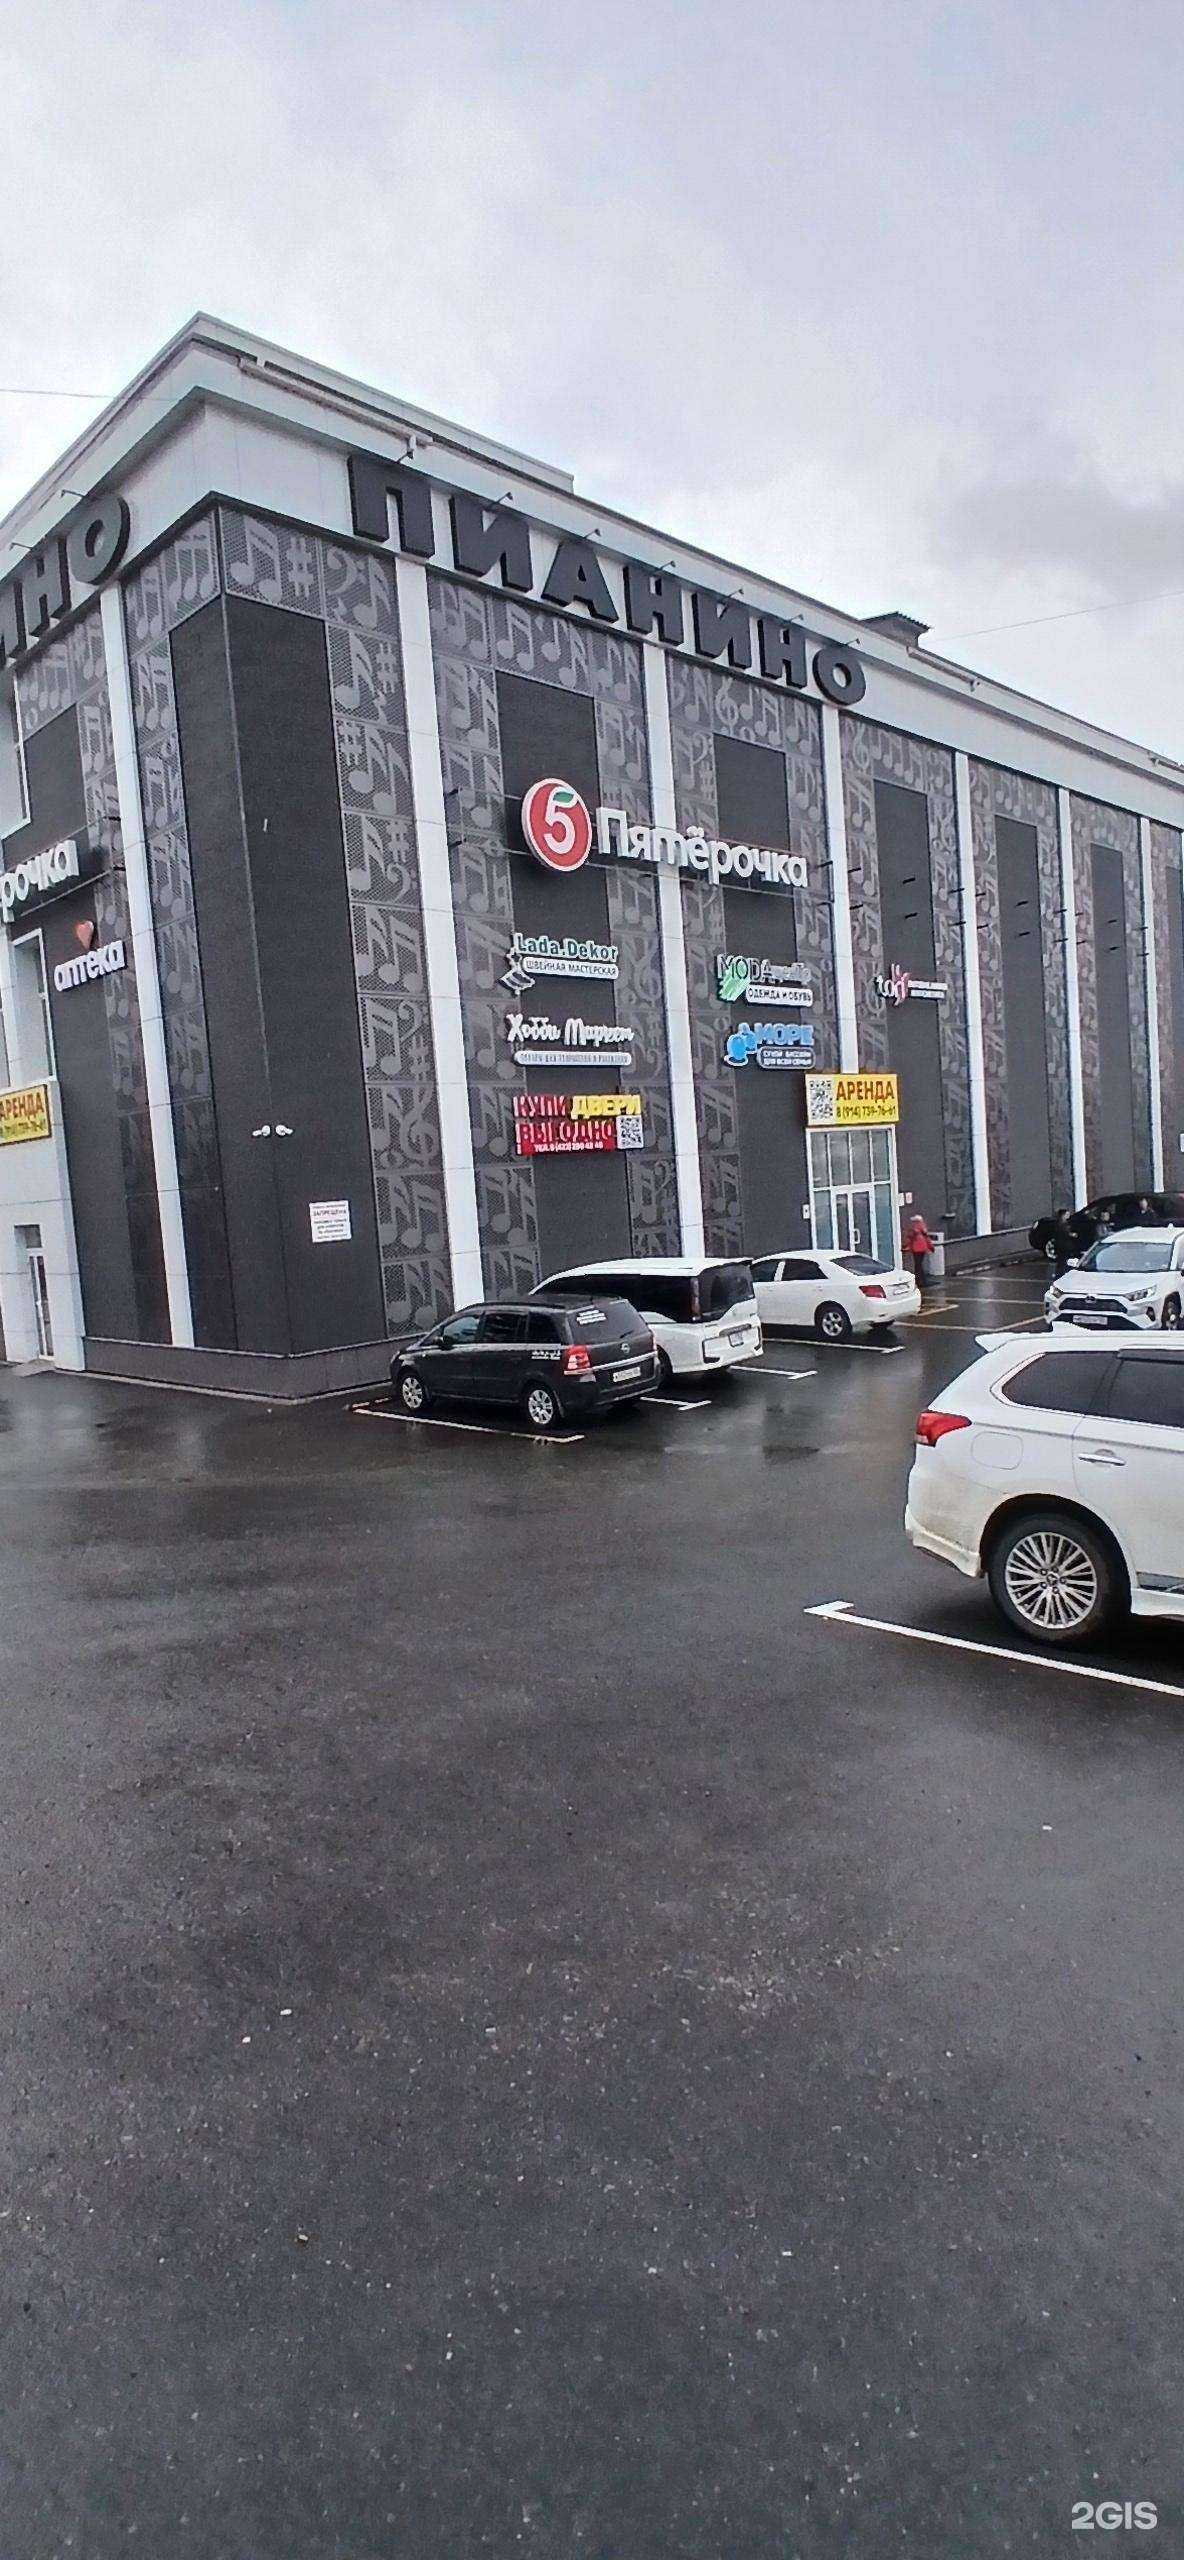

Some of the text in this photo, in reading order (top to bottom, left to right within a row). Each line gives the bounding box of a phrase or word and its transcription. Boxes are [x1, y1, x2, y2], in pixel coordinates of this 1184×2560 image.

[347, 455, 867, 706] ПИАНИНО
[596, 806, 808, 888] Пятёрочка
[54, 940, 126, 992] аптека
[568, 963, 617, 976] МАСТЕРСКАЯ
[747, 988, 781, 999] ОДЕЖДА
[789, 991, 812, 1002] ОБУВЬ
[754, 1022, 815, 1047] МОРЕ
[836, 1081, 895, 1103] АРЕНДА
[513, 1094, 641, 1119] КУПИ ДВЕРИ
